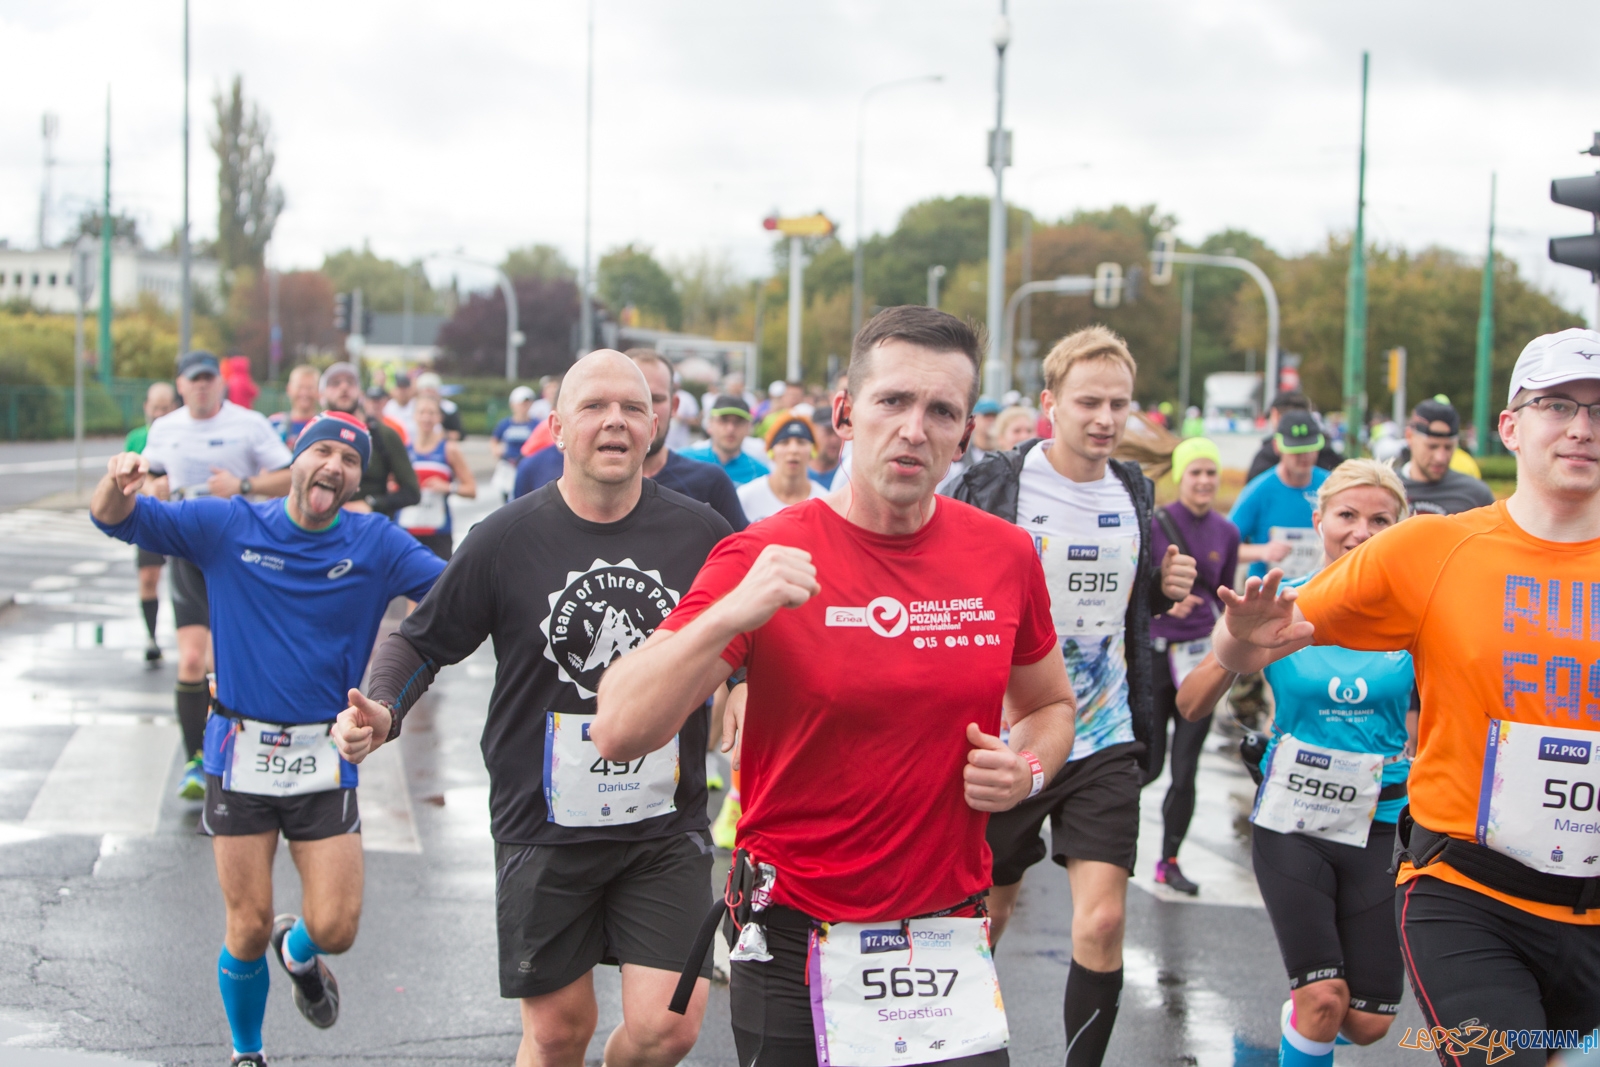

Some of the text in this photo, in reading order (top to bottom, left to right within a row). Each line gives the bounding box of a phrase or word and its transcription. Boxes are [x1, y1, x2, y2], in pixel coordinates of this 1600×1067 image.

[1068, 572, 1119, 592] 6315
[551, 572, 672, 644] Team of Three Pea
[909, 597, 983, 613] CHALLENGE
[1077, 598, 1106, 607] Adrian
[835, 614, 863, 623] Enea
[909, 610, 951, 625] POZNAŃ
[960, 610, 996, 622] POLAND
[925, 637, 938, 649] 1,5
[956, 635, 969, 647] 40
[985, 634, 1001, 646] 10,4
[1561, 745, 1587, 758] PKO
[255, 753, 317, 775] 3943
[590, 755, 648, 776] 497
[272, 780, 298, 788] Adam
[598, 781, 640, 793] Dariusz
[1286, 773, 1357, 803] 5960
[1542, 778, 1600, 812] 50
[1293, 798, 1341, 815] Krystiana
[881, 934, 906, 947] PKO
[1317, 968, 1338, 979] cep
[862, 967, 959, 1000] 5637
[878, 1006, 954, 1022] Sebastian
